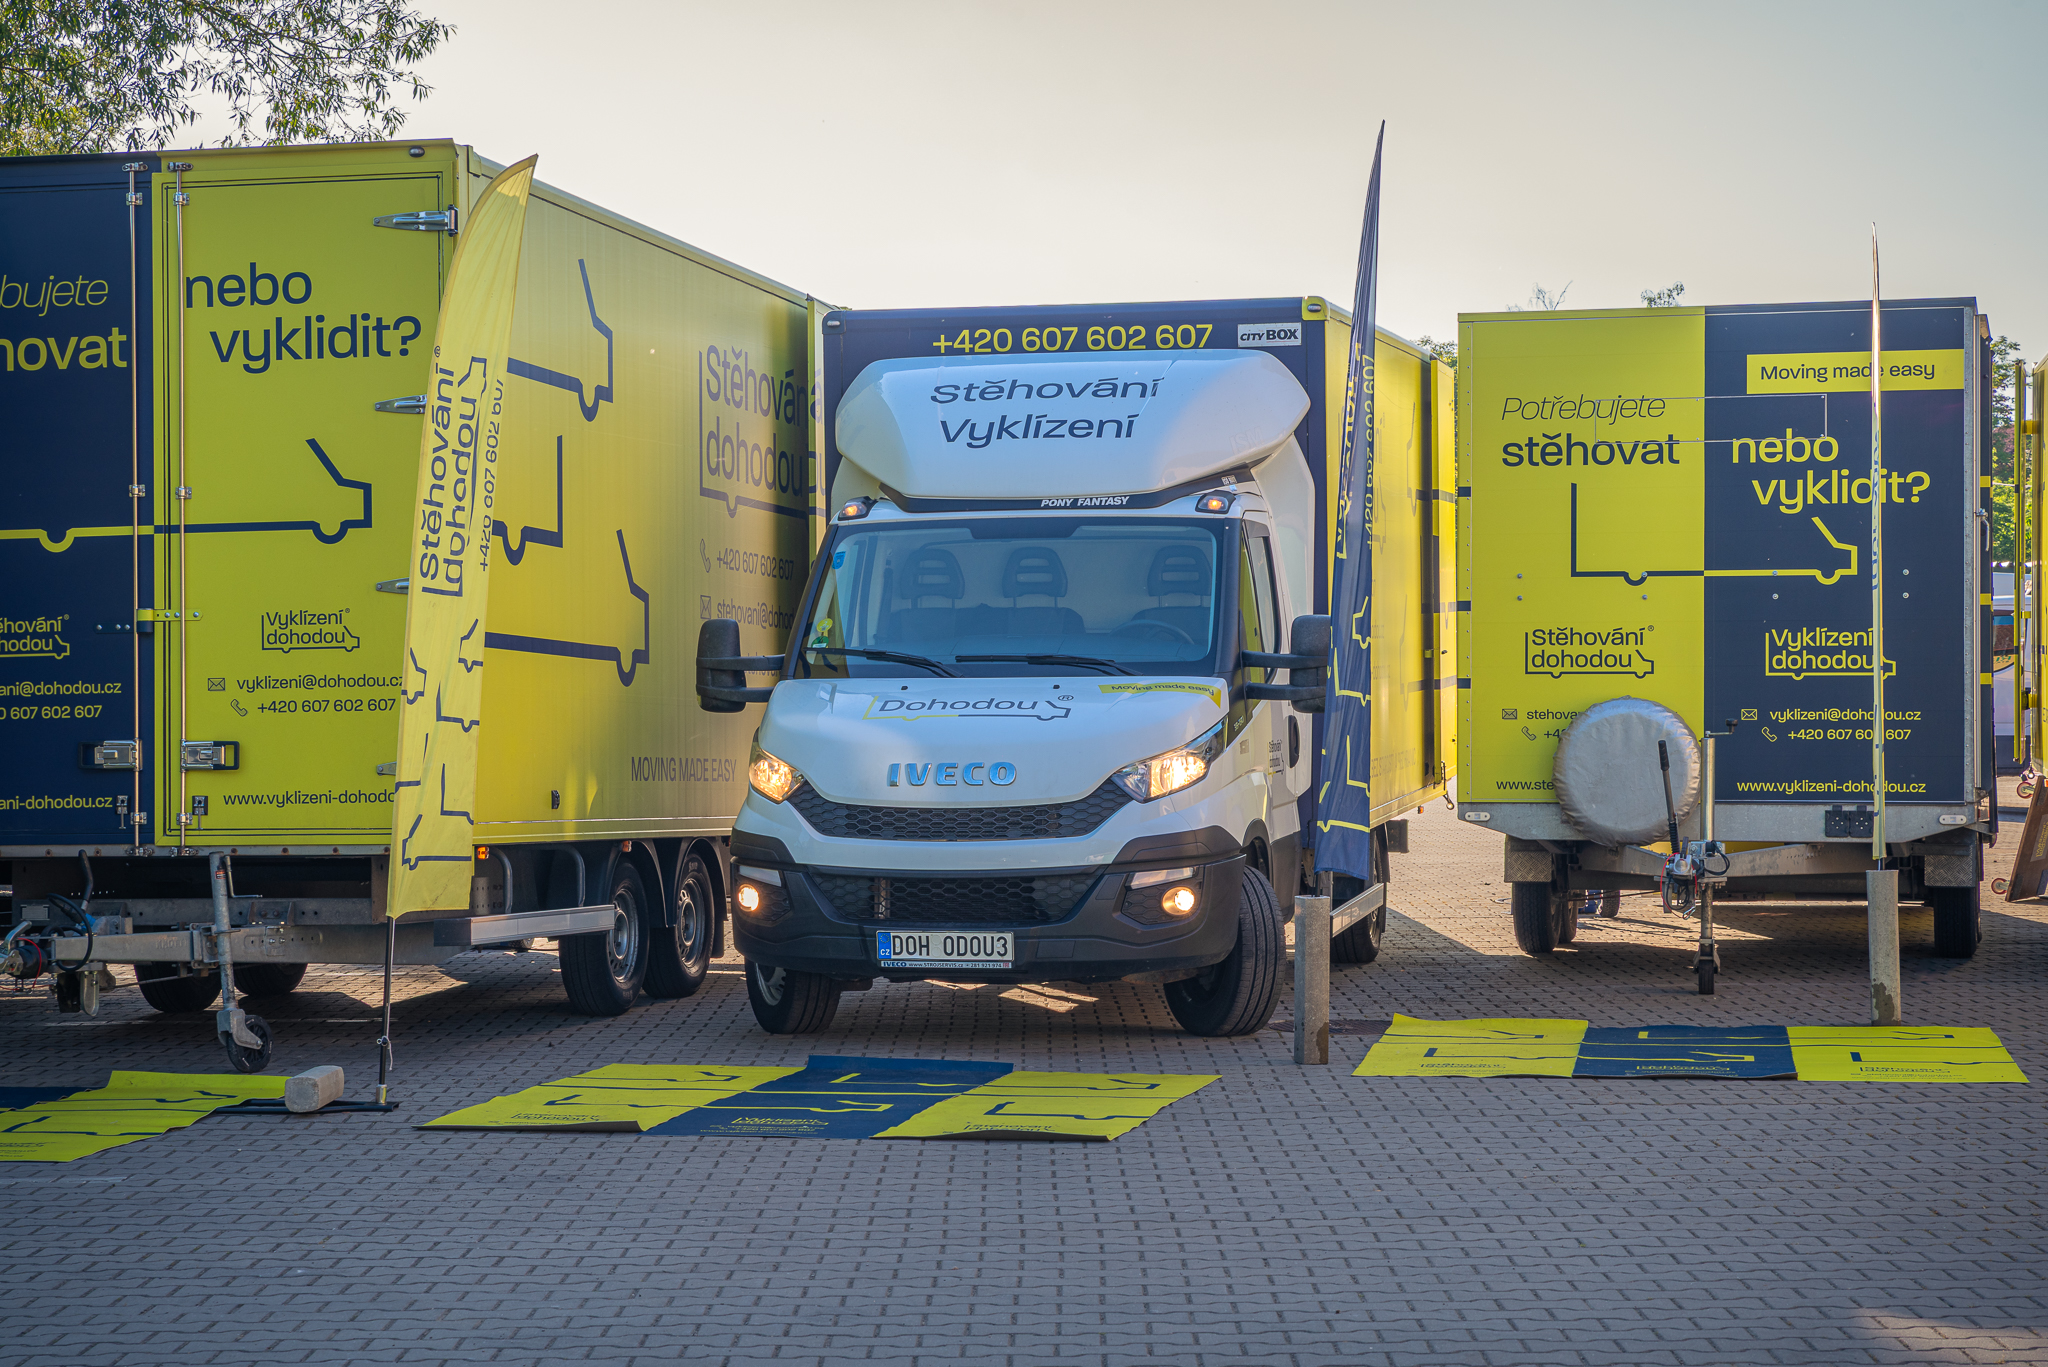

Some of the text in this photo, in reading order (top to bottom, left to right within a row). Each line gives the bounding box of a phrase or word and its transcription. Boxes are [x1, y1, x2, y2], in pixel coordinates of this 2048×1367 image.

[186, 262, 312, 308] nebo
[209, 313, 422, 374] vyklidit?
[932, 325, 1213, 353] +420 607 602 607
[1240, 329, 1299, 341] CITY BOX
[1760, 364, 1828, 383] Moving
[1889, 362, 1935, 380] easy
[931, 377, 1165, 404] Stěhování
[1502, 394, 1666, 426] Potřebujete
[939, 414, 1139, 449] Vyklízení
[1502, 432, 1680, 466] stěhovat
[1732, 428, 1839, 463] nebo
[1041, 497, 1130, 507] PONY FANTASY
[1752, 469, 1931, 514] vyklidit?
[717, 548, 794, 581] +420 607 602 607
[267, 628, 345, 645] dohodou
[1532, 650, 1632, 668] dohodou
[1112, 684, 1151, 692] Moving
[1189, 684, 1215, 697] easy
[10, 706, 38, 720] 607
[41, 705, 71, 719] 602
[74, 704, 103, 718] 607
[257, 698, 396, 714] +420 607 602 607
[879, 698, 1038, 712] Dohodou
[1788, 729, 1823, 740] +420
[1827, 729, 1852, 740] 607
[1885, 729, 1911, 740] 607
[631, 756, 737, 783] MOVING MADE EASY
[887, 762, 1017, 787] IVECO
